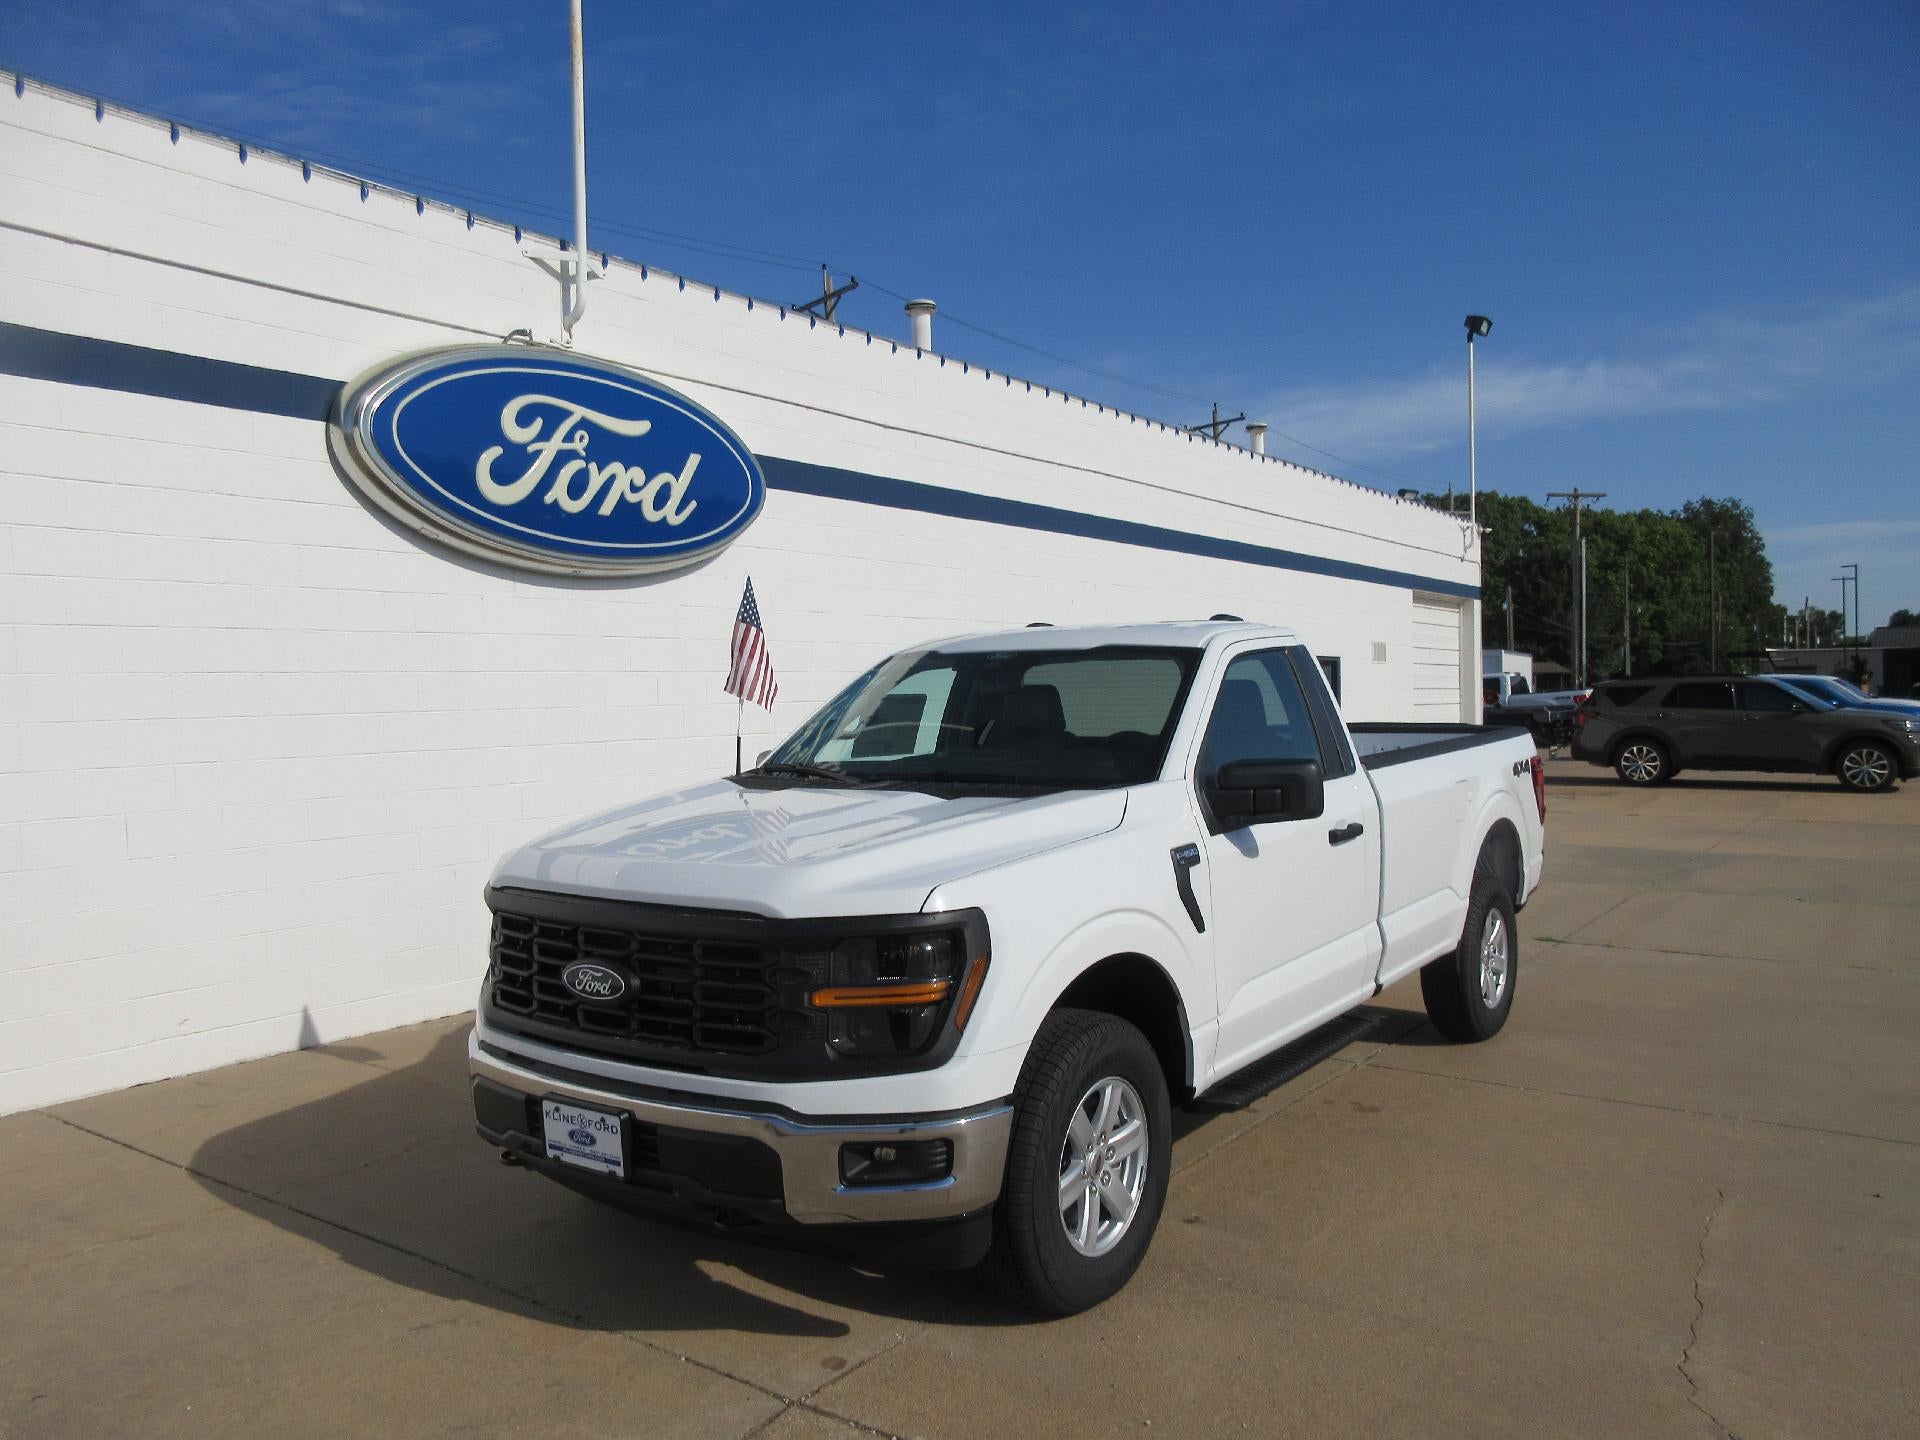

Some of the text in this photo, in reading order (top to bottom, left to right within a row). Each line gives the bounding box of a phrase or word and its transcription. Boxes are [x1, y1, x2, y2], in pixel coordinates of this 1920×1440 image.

[476, 394, 701, 526] Ford
[576, 969, 612, 995] Ford
[545, 1109, 577, 1125] KLINE
[587, 1119, 618, 1135] FORD
